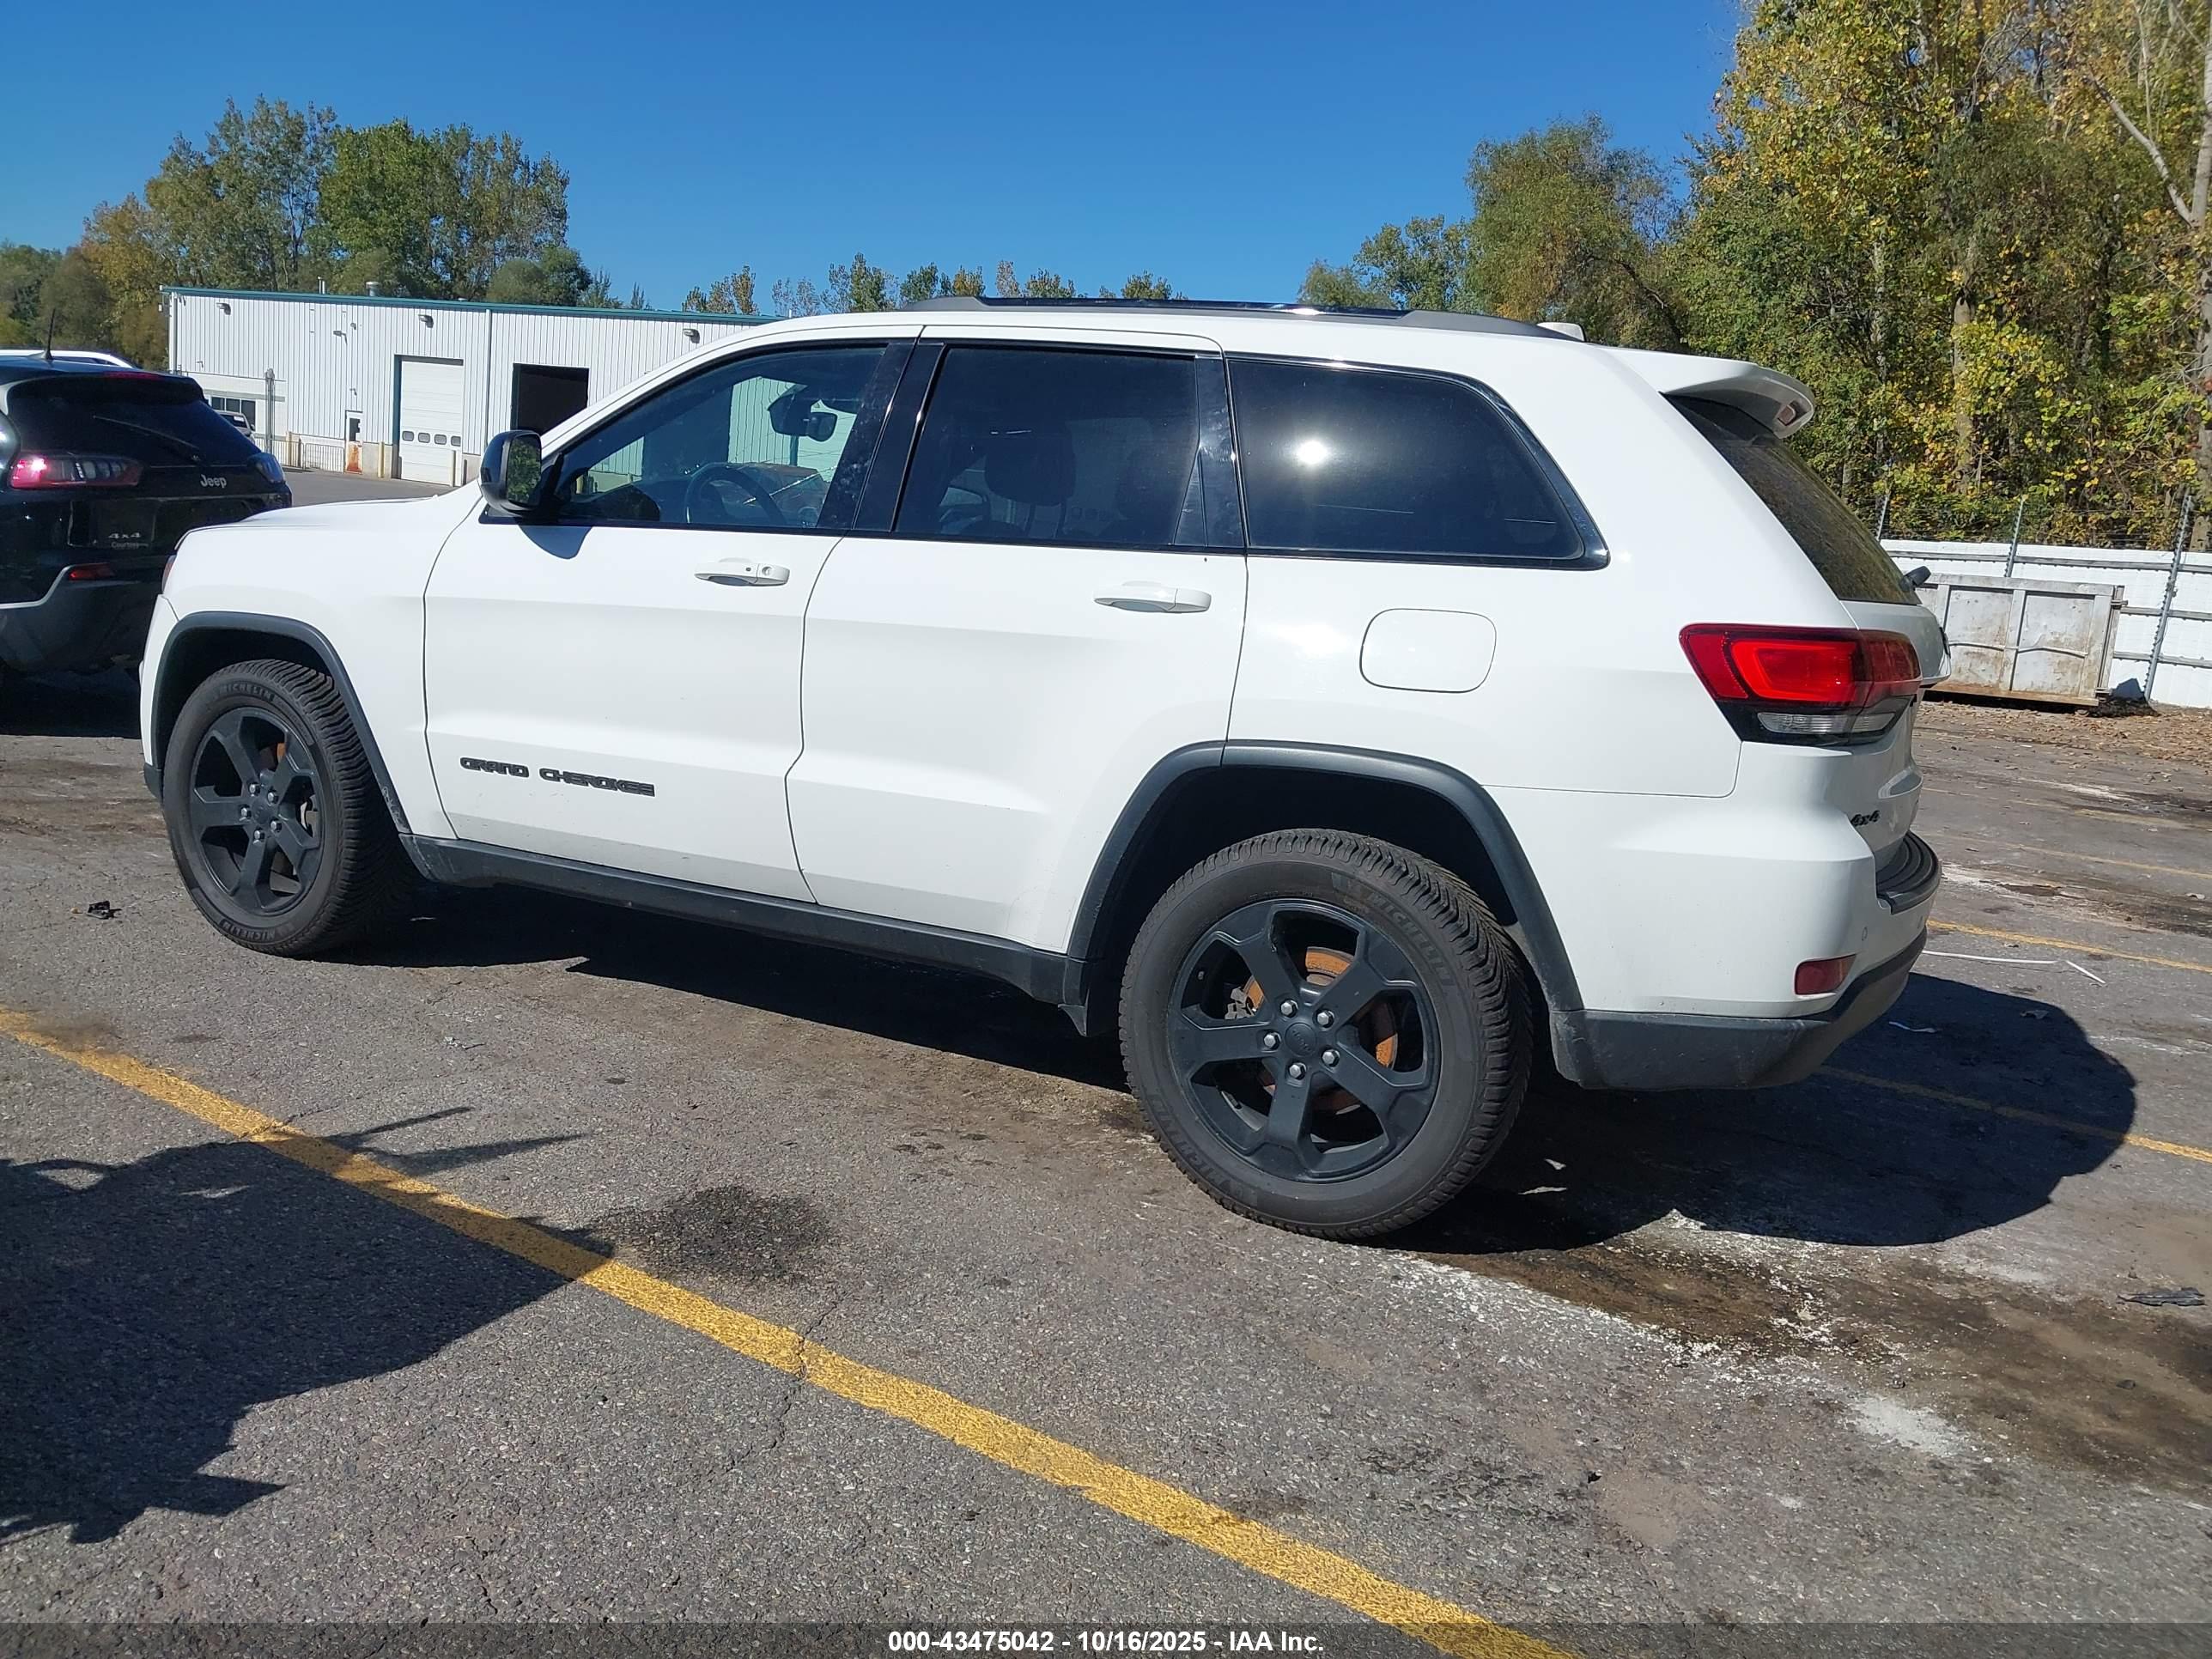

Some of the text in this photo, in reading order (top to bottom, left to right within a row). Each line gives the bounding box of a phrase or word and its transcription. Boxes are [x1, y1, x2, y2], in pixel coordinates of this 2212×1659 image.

[200, 474, 227, 488] Jeep
[220, 684, 275, 701] MICHELIN
[460, 757, 655, 797] GRAND CHEROKEE
[222, 920, 275, 941] MICHELIN
[1367, 891, 1454, 985] MICHELIN
